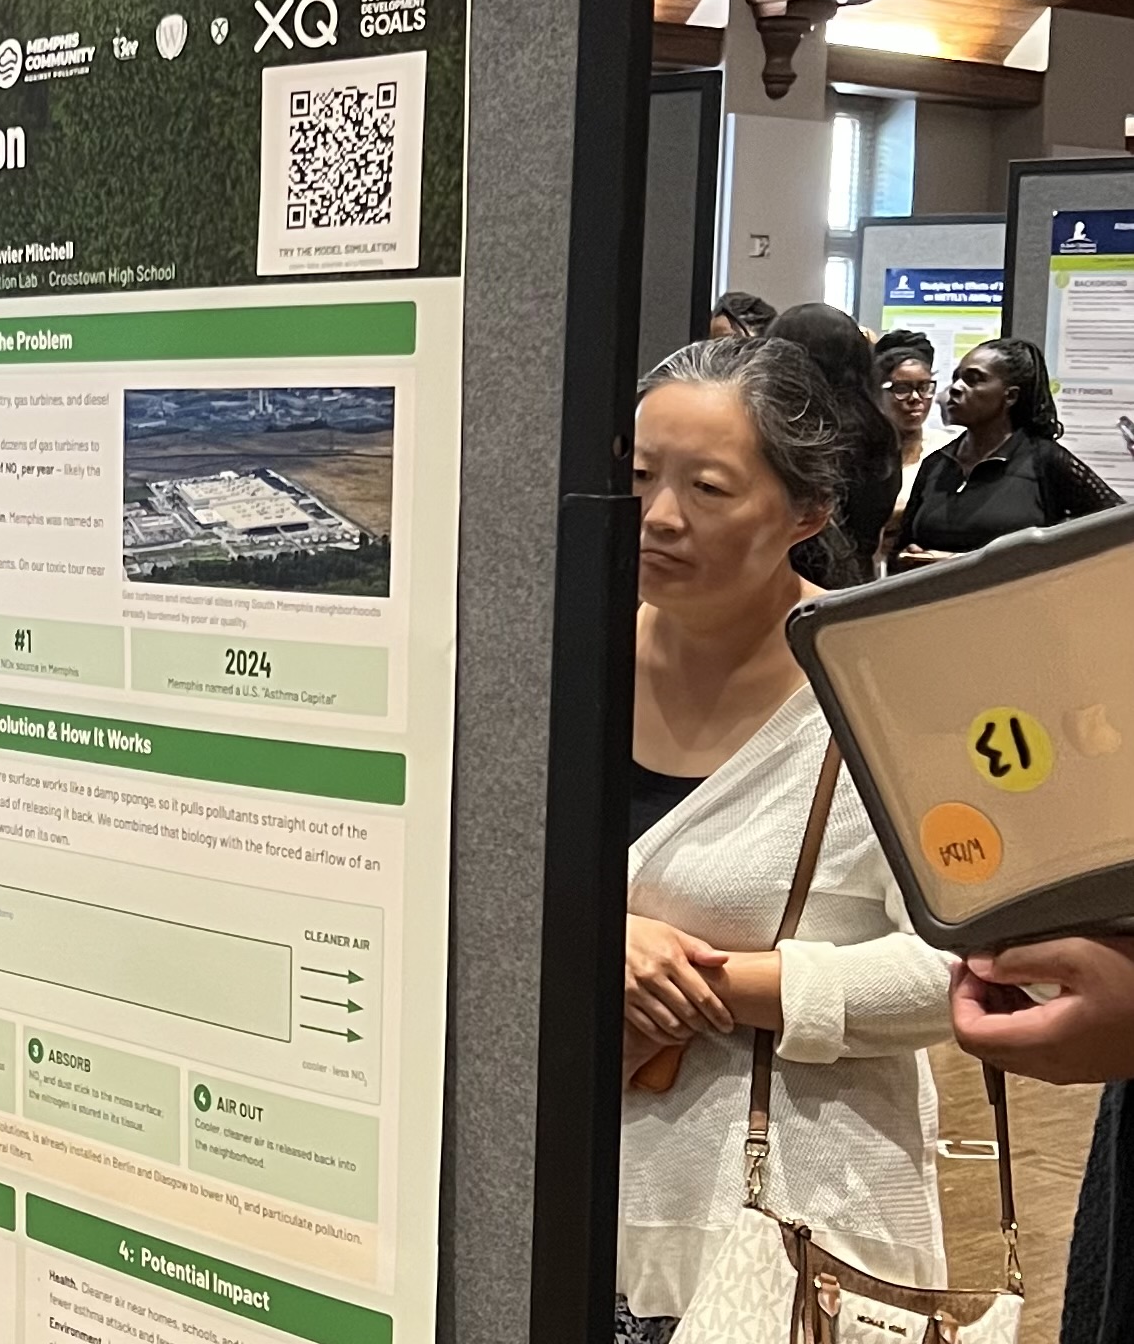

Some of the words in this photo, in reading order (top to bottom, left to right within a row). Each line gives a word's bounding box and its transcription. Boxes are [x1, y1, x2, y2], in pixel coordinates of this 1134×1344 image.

[360, 7, 426, 38] GOALS
[25, 46, 96, 71] COMMUNITY
[26, 32, 80, 55] MEMPHIS
[24, 240, 74, 263] Mitchell
[16, 328, 72, 351] Problem
[15, 629, 33, 654] #1
[225, 648, 272, 678] 2024
[166, 677, 203, 692] Memphis
[204, 683, 234, 695] named
[234, 686, 240, 696] a
[241, 684, 260, 698] U.S.
[260, 686, 299, 702] "Asthma
[300, 689, 337, 706] Capital"
[46, 719, 58, 741] &
[60, 721, 91, 745] How
[93, 726, 104, 748] It
[106, 727, 152, 754] Works
[975, 717, 1032, 778] 13
[157, 798, 170, 810] so
[170, 797, 178, 812] it
[179, 801, 204, 816] pulls
[205, 804, 259, 825] pollutants
[260, 813, 306, 833] straight
[308, 821, 328, 835] out
[330, 822, 344, 837] of
[346, 824, 368, 840] the
[96, 811, 112, 827] We
[112, 817, 158, 836] combined
[159, 824, 179, 840] that
[180, 826, 218, 849] biology
[218, 835, 243, 850] with
[244, 838, 263, 854] the
[264, 840, 302, 860] forced
[304, 847, 346, 866] airflow
[348, 854, 362, 869] of
[363, 858, 380, 871] an
[303, 928, 350, 948] CLEANER
[351, 937, 370, 951] AIR
[32, 1045, 40, 1057] 3
[48, 1049, 92, 1073] ABSORB
[198, 1091, 207, 1105] 4
[216, 1096, 236, 1117] AIR
[240, 1099, 264, 1123] OUT
[194, 1116, 220, 1134] Cooler,
[222, 1127, 253, 1144] cleaner
[253, 1136, 265, 1146] air
[266, 1139, 274, 1150] is
[274, 1142, 312, 1161] released
[313, 1151, 336, 1166] back
[337, 1157, 356, 1172] into
[118, 1239, 134, 1263] 4:
[140, 1246, 210, 1290] Potential
[212, 1271, 270, 1312] Impact
[80, 1280, 113, 1303] Cleaner
[114, 1296, 126, 1308] air
[126, 1300, 146, 1316] near
[146, 1306, 180, 1331] homes,
[181, 1322, 220, 1344] schools,
